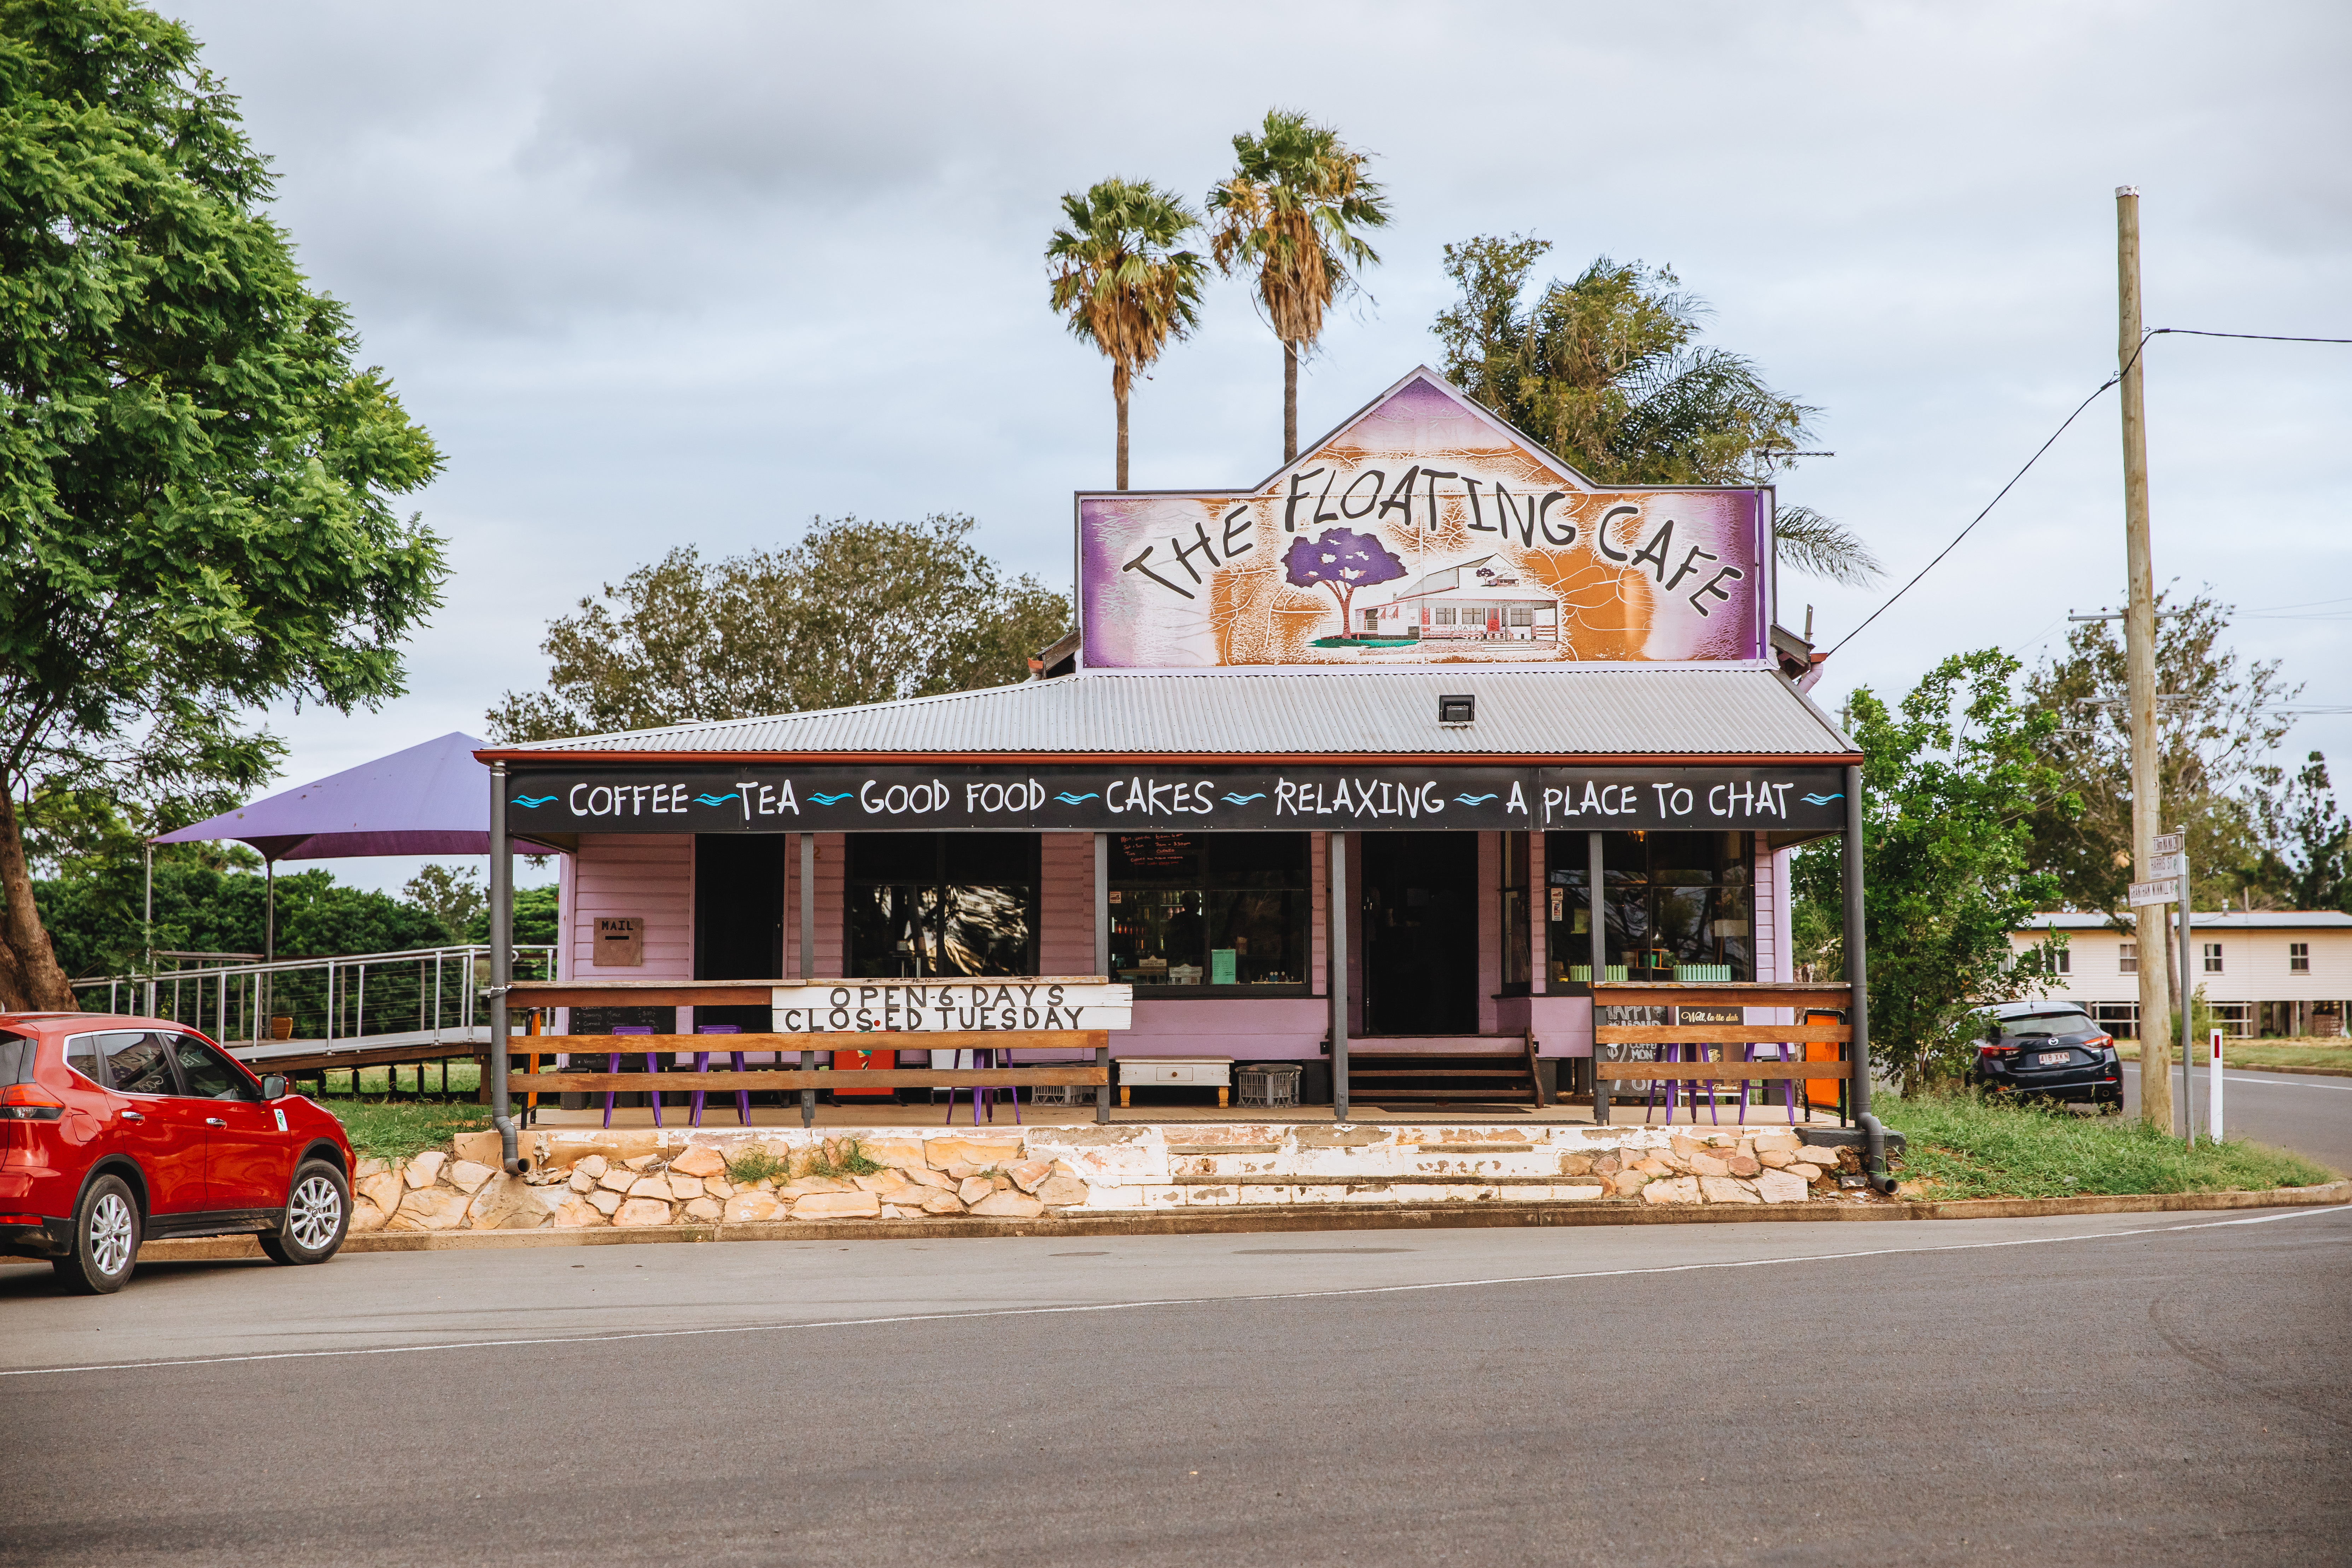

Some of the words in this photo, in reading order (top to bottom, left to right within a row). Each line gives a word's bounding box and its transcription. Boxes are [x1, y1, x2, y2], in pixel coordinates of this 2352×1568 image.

[1122, 505, 1253, 599] THE
[1285, 466, 1576, 548] FLOATING
[1599, 506, 1744, 617] CAFE
[570, 783, 688, 816] COFFEE
[736, 779, 799, 820] TEA
[860, 779, 950, 814] GOOD
[967, 779, 1045, 813] FOOD
[1107, 777, 1214, 816] CAKES
[1274, 777, 1445, 818] RELAXING
[1506, 781, 1528, 815] A
[1543, 781, 1637, 823] PLACE
[1652, 782, 1693, 818] TO
[1709, 781, 1794, 819] CHAT
[2151, 857, 2166, 871] HARRIS
[2168, 856, 2172, 869] ST
[601, 920, 634, 931] MAIL
[785, 1007, 922, 1031] CLOSED
[934, 1007, 1084, 1030] TUESDAY
[1726, 1013, 1739, 1022] dah
